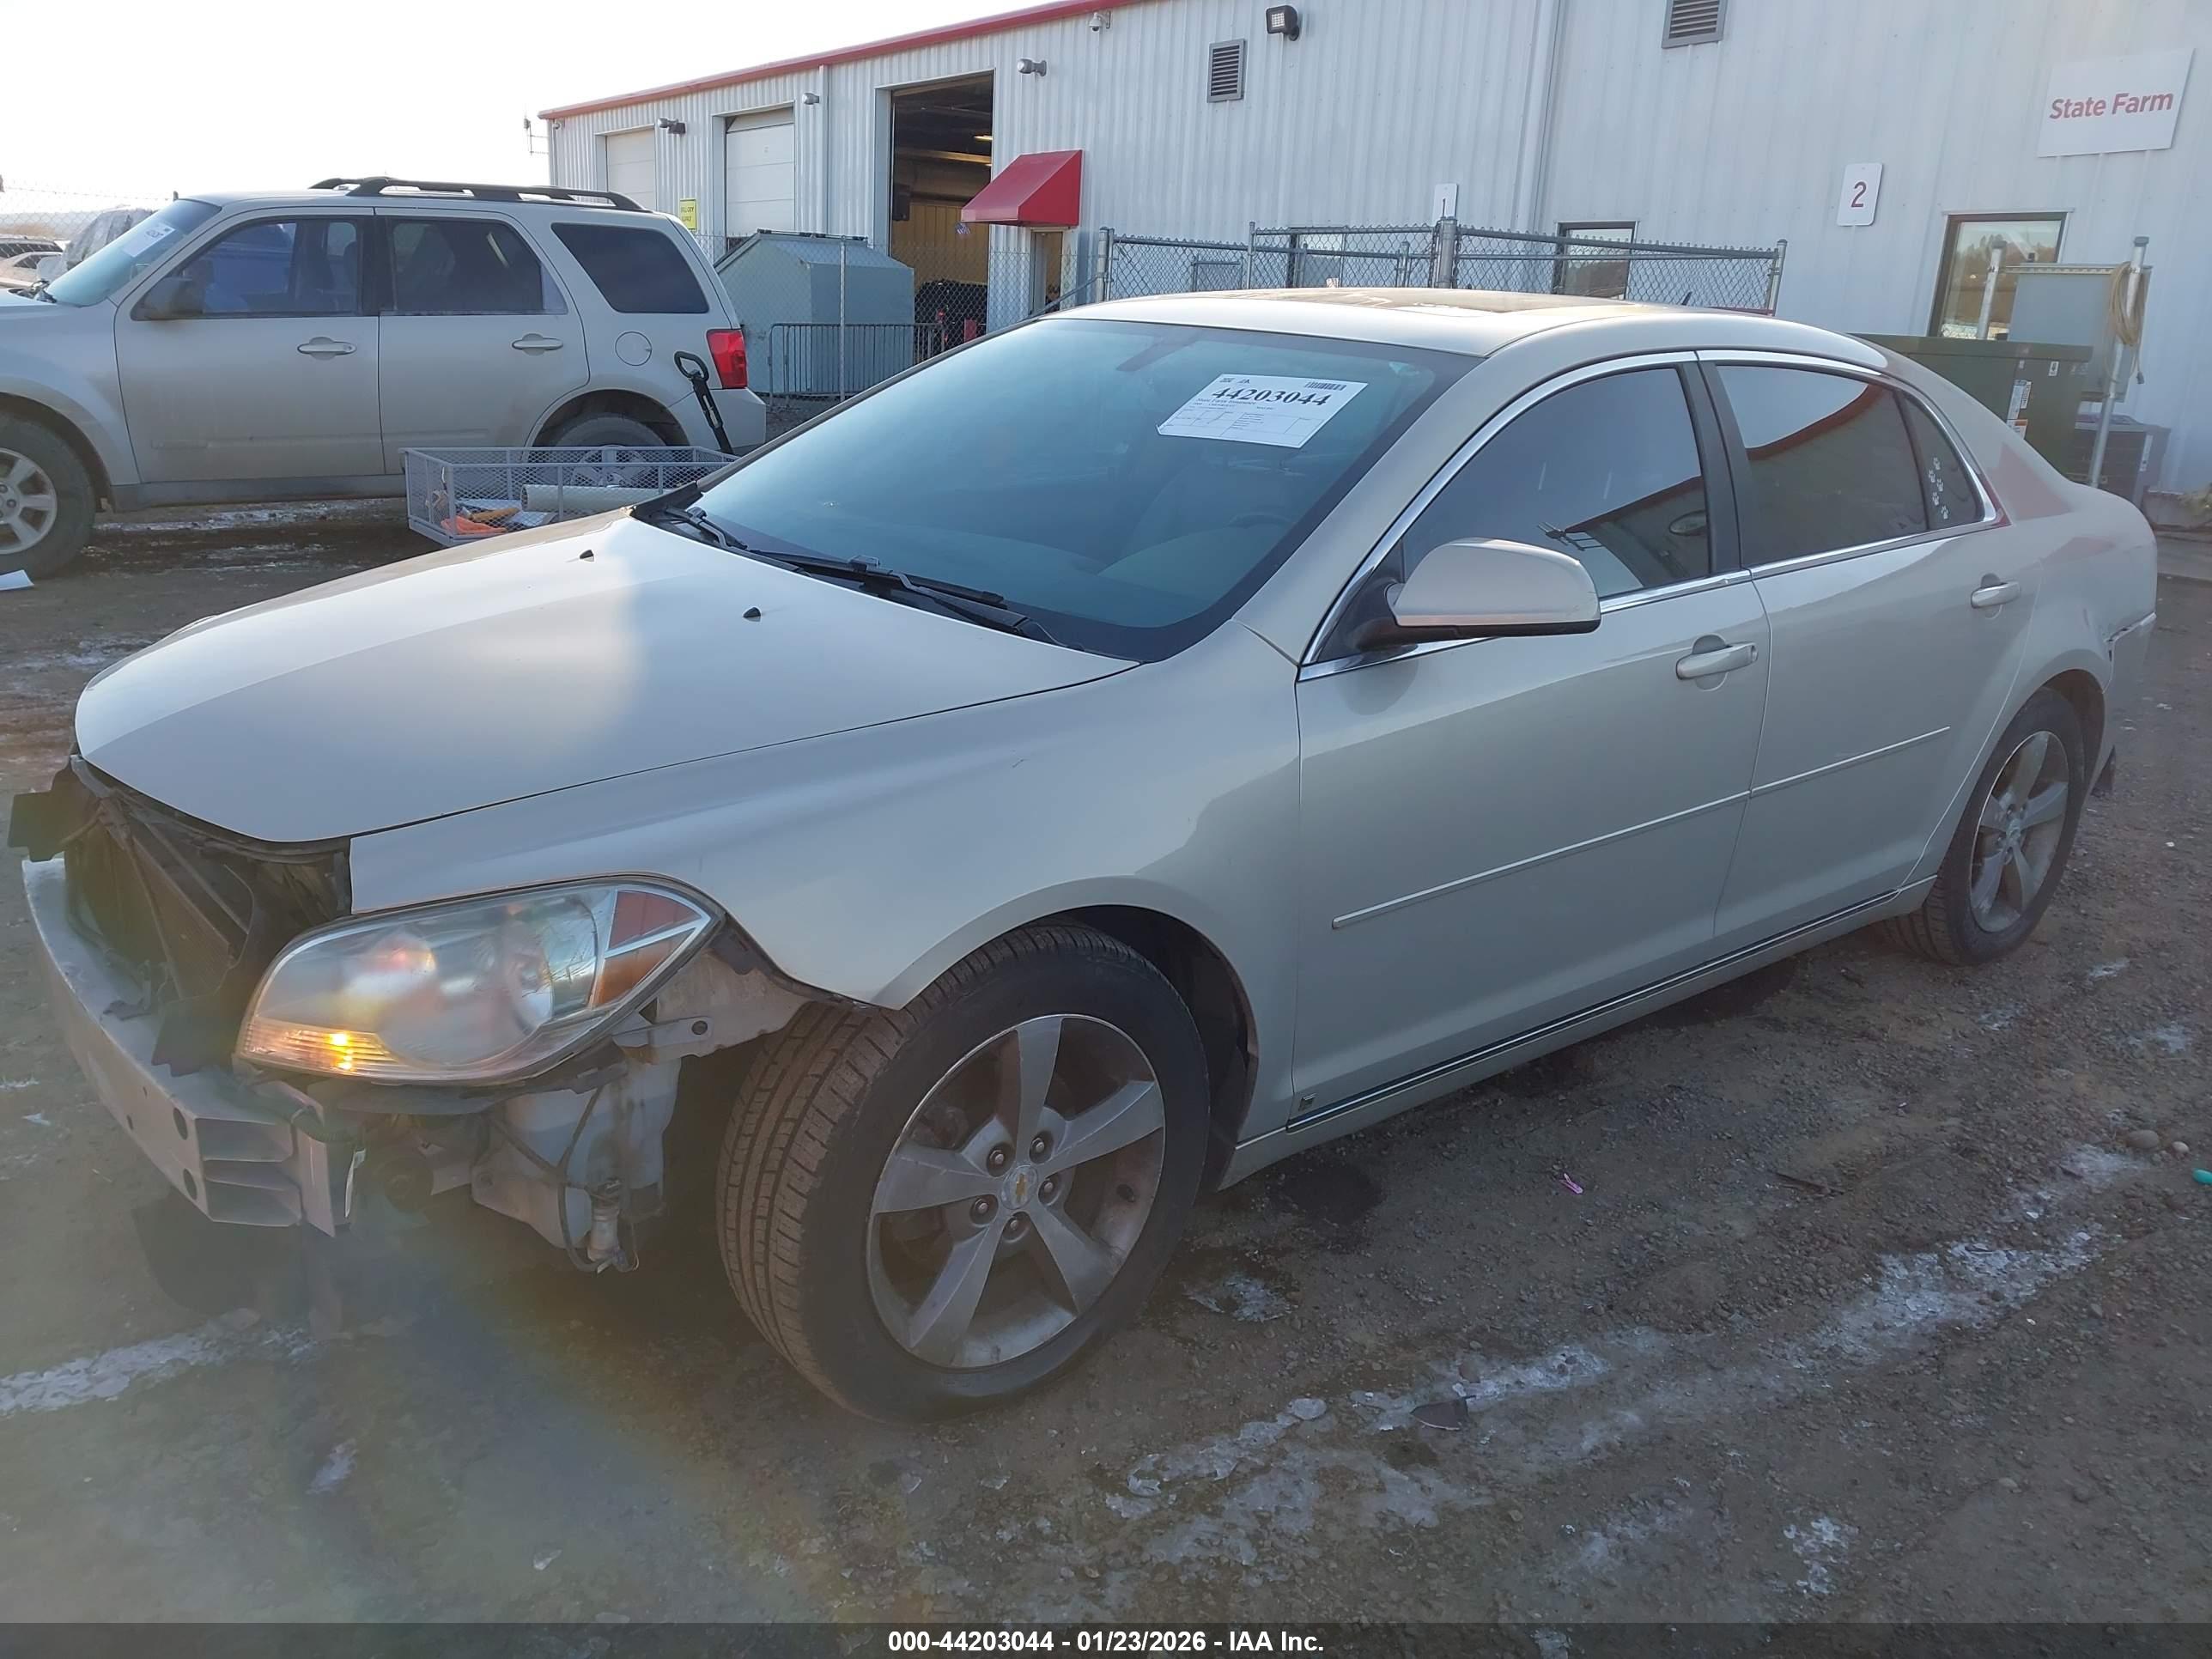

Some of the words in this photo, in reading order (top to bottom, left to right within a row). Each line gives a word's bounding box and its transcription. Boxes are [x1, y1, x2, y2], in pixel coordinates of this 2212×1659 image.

[2049, 98, 2106, 119] State
[2112, 92, 2174, 115] Farm
[1850, 181, 1867, 208] 2
[1212, 387, 1332, 406] 44203044
